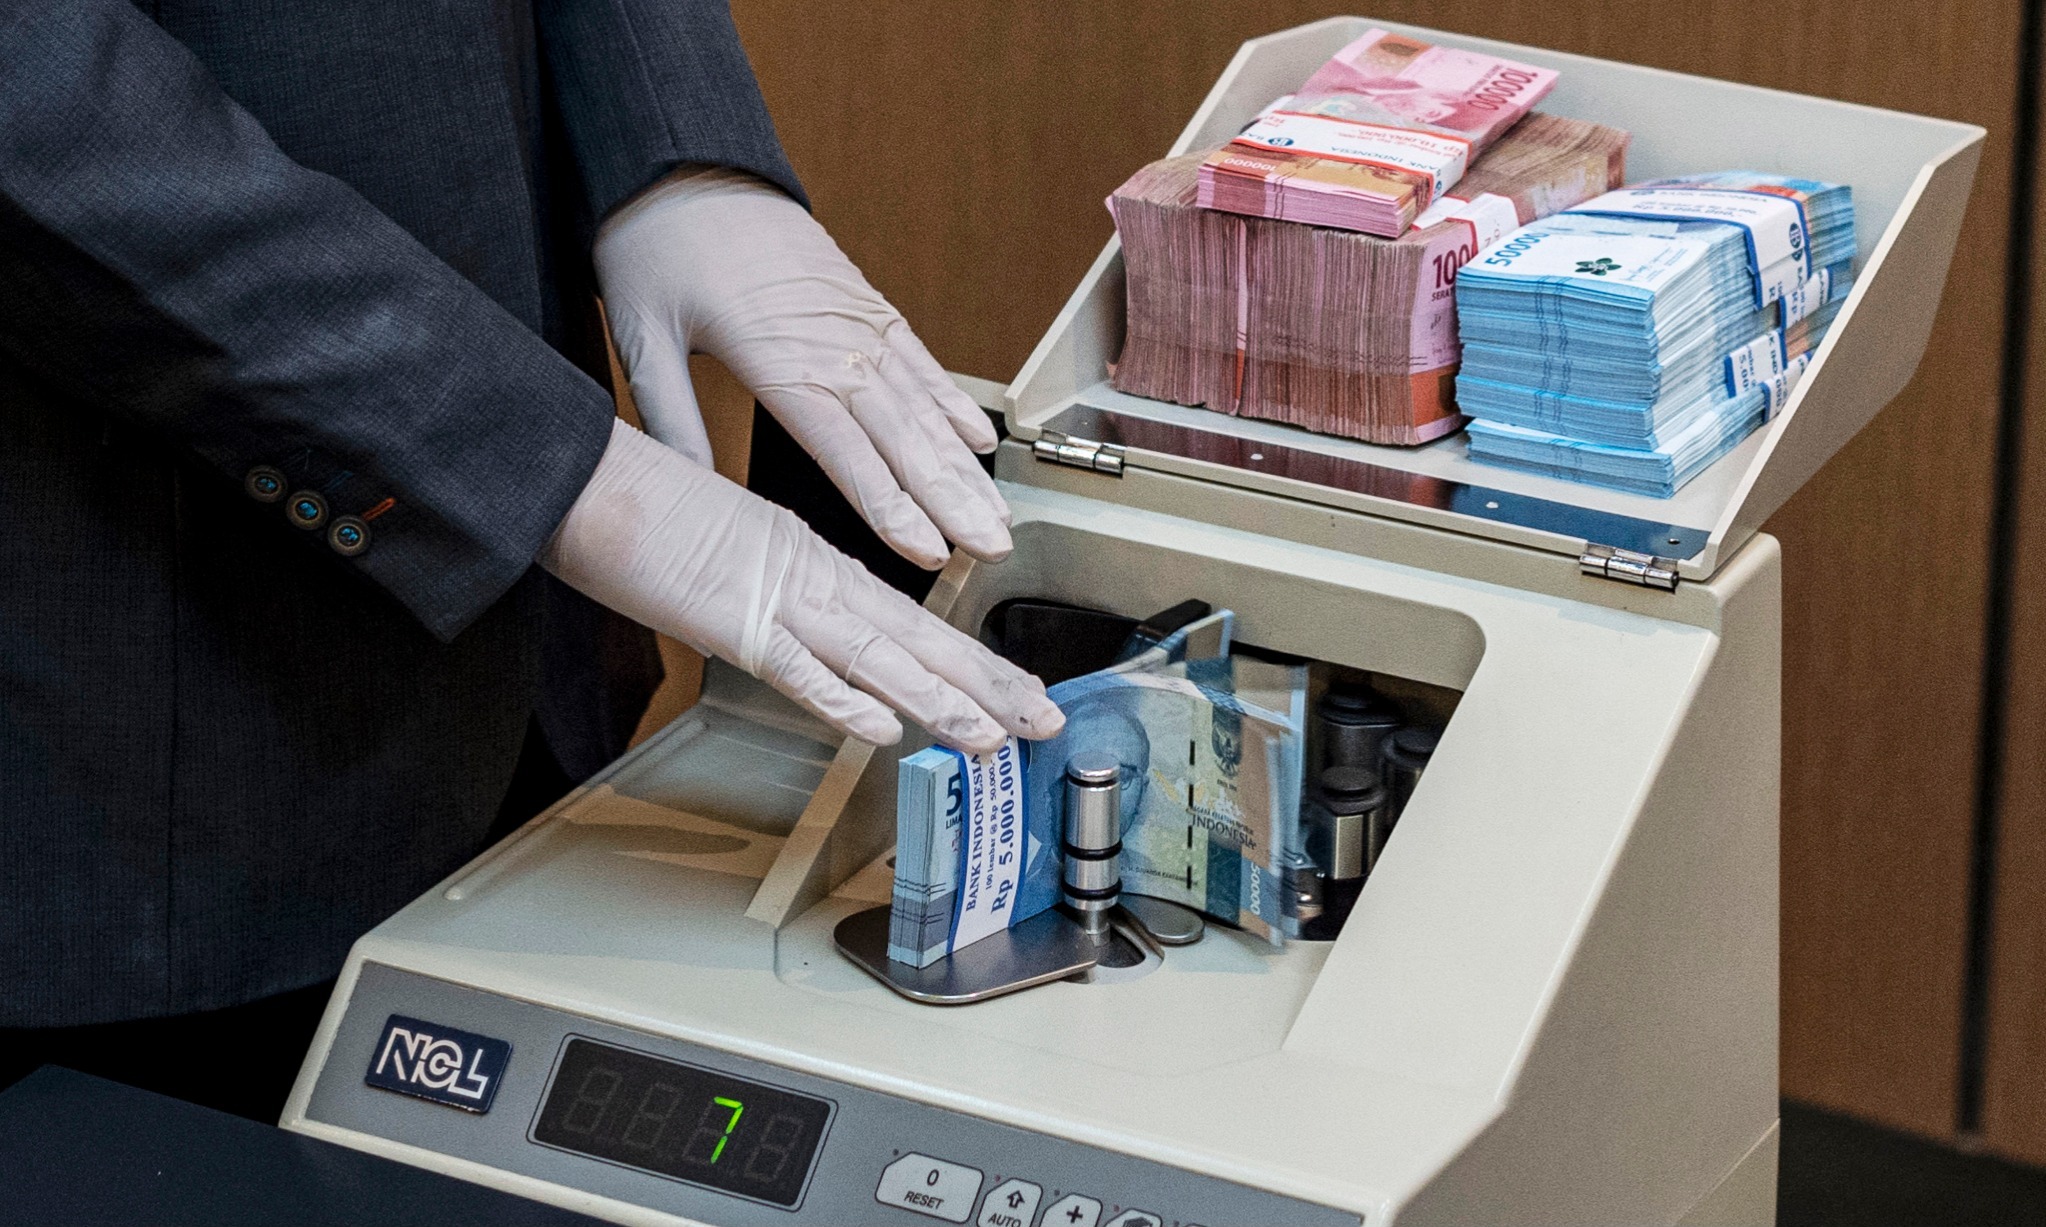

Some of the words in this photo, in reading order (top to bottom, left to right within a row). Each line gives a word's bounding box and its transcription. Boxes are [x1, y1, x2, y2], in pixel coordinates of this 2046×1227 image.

[1466, 67, 1538, 111] 100000
[1223, 157, 1277, 173] 100000
[1331, 146, 1404, 163] INDONESIA
[1484, 231, 1551, 268] 50000
[970, 753, 985, 861] INDONESIA
[990, 804, 999, 823] Rp
[1191, 814, 1257, 850] INDONESIA
[987, 837, 996, 873] lembar
[965, 861, 982, 912] BANK
[985, 873, 994, 891] 100
[990, 878, 1014, 915] Rp
[1250, 862, 1261, 916] 50000
[709, 1095, 746, 1165] 7
[903, 1190, 945, 1210] RESET
[987, 1212, 1022, 1227] AUTO
